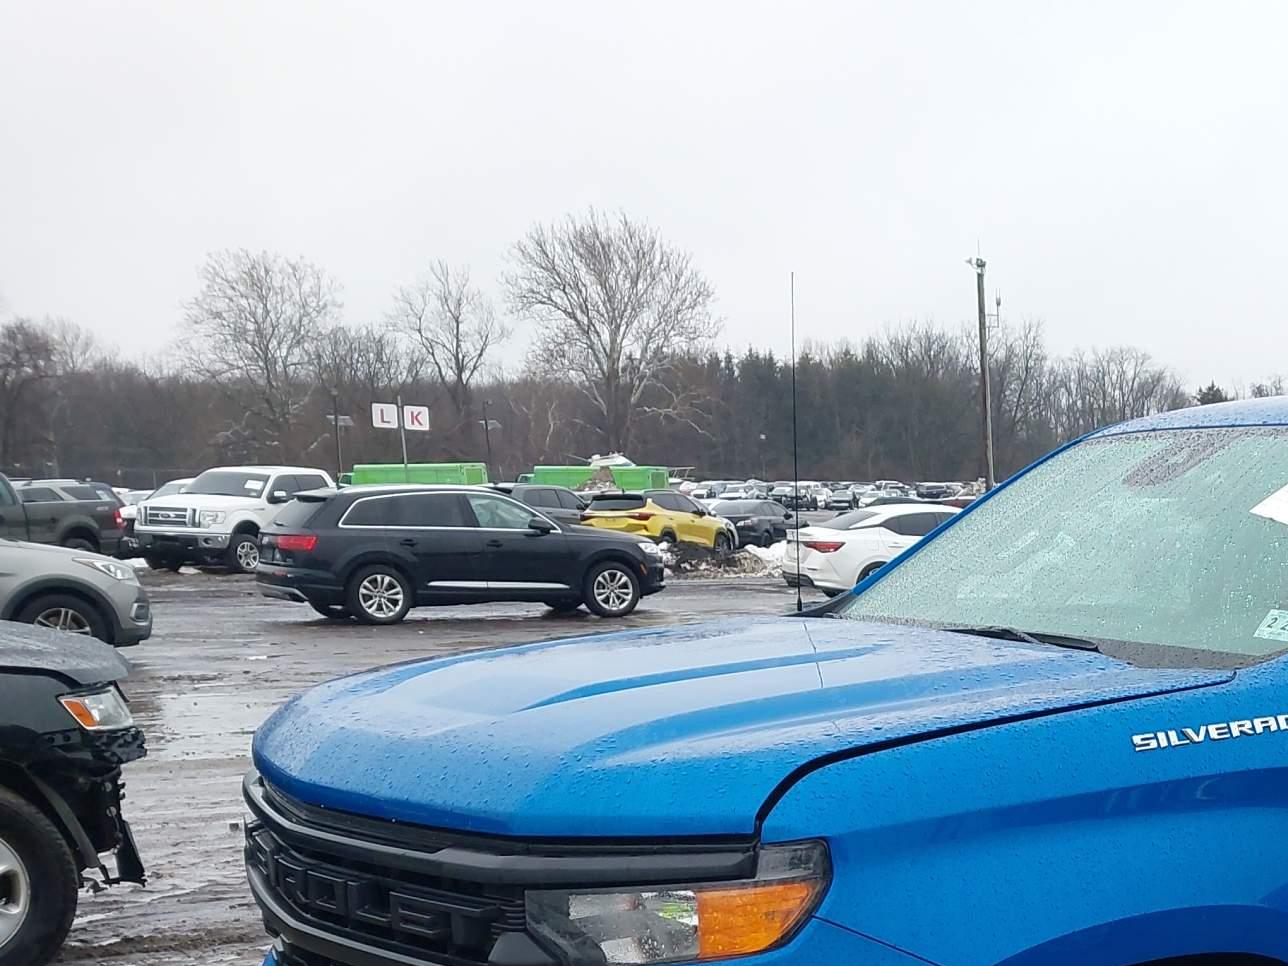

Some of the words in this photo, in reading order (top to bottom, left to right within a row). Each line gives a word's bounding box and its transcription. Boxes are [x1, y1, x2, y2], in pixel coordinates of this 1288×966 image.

[380, 408, 391, 423] L
[411, 411, 424, 426] K
[1267, 617, 1278, 628] 2
